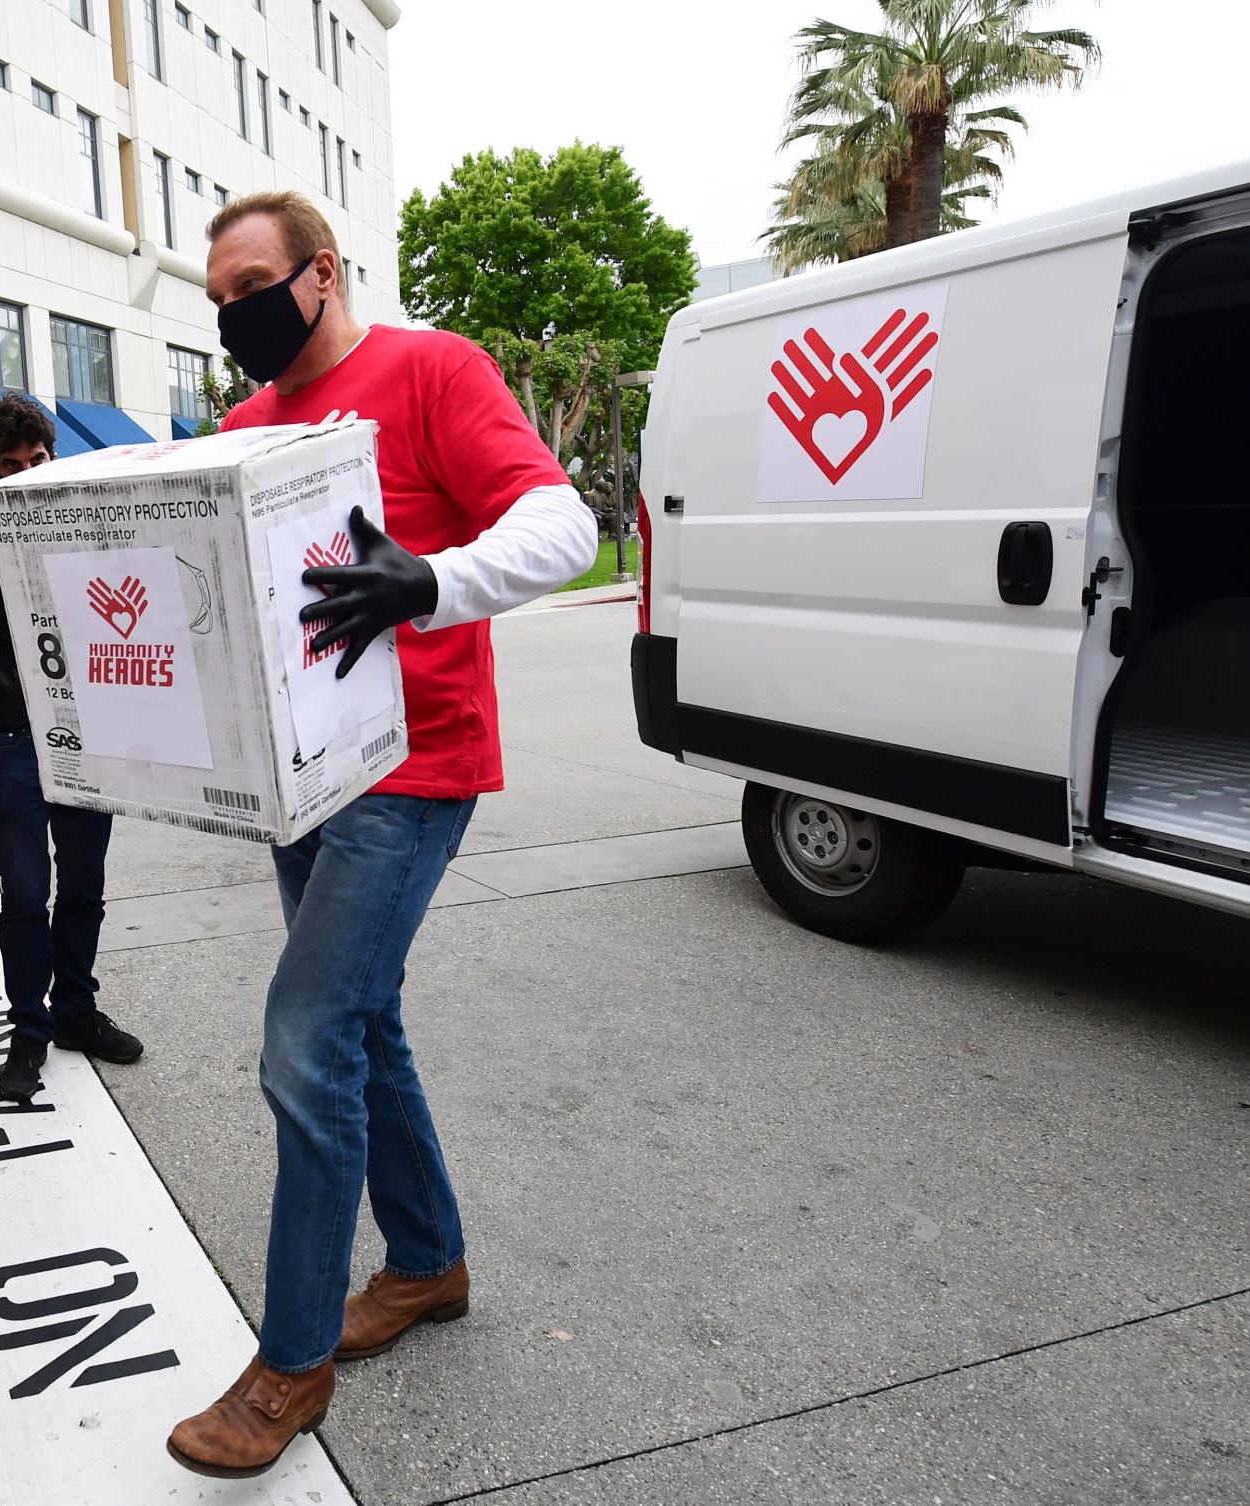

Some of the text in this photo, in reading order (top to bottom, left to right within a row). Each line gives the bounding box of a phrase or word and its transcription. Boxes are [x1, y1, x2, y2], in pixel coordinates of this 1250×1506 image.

[250, 457, 364, 507] DISPOSABLE RESPIRATORY PROTECTION
[55, 505, 132, 524] RESPIRATORY
[135, 500, 219, 521] PROTECTION
[252, 484, 330, 519] N95 Particulate Respirator
[16, 529, 73, 543] Particulate
[75, 528, 136, 543] Respirator
[30, 613, 59, 628] Part
[37, 632, 67, 680] 8
[89, 643, 175, 659] HUMANITY
[88, 657, 174, 687] HEROES
[46, 687, 59, 699] 12
[45, 732, 83, 751] SAS
